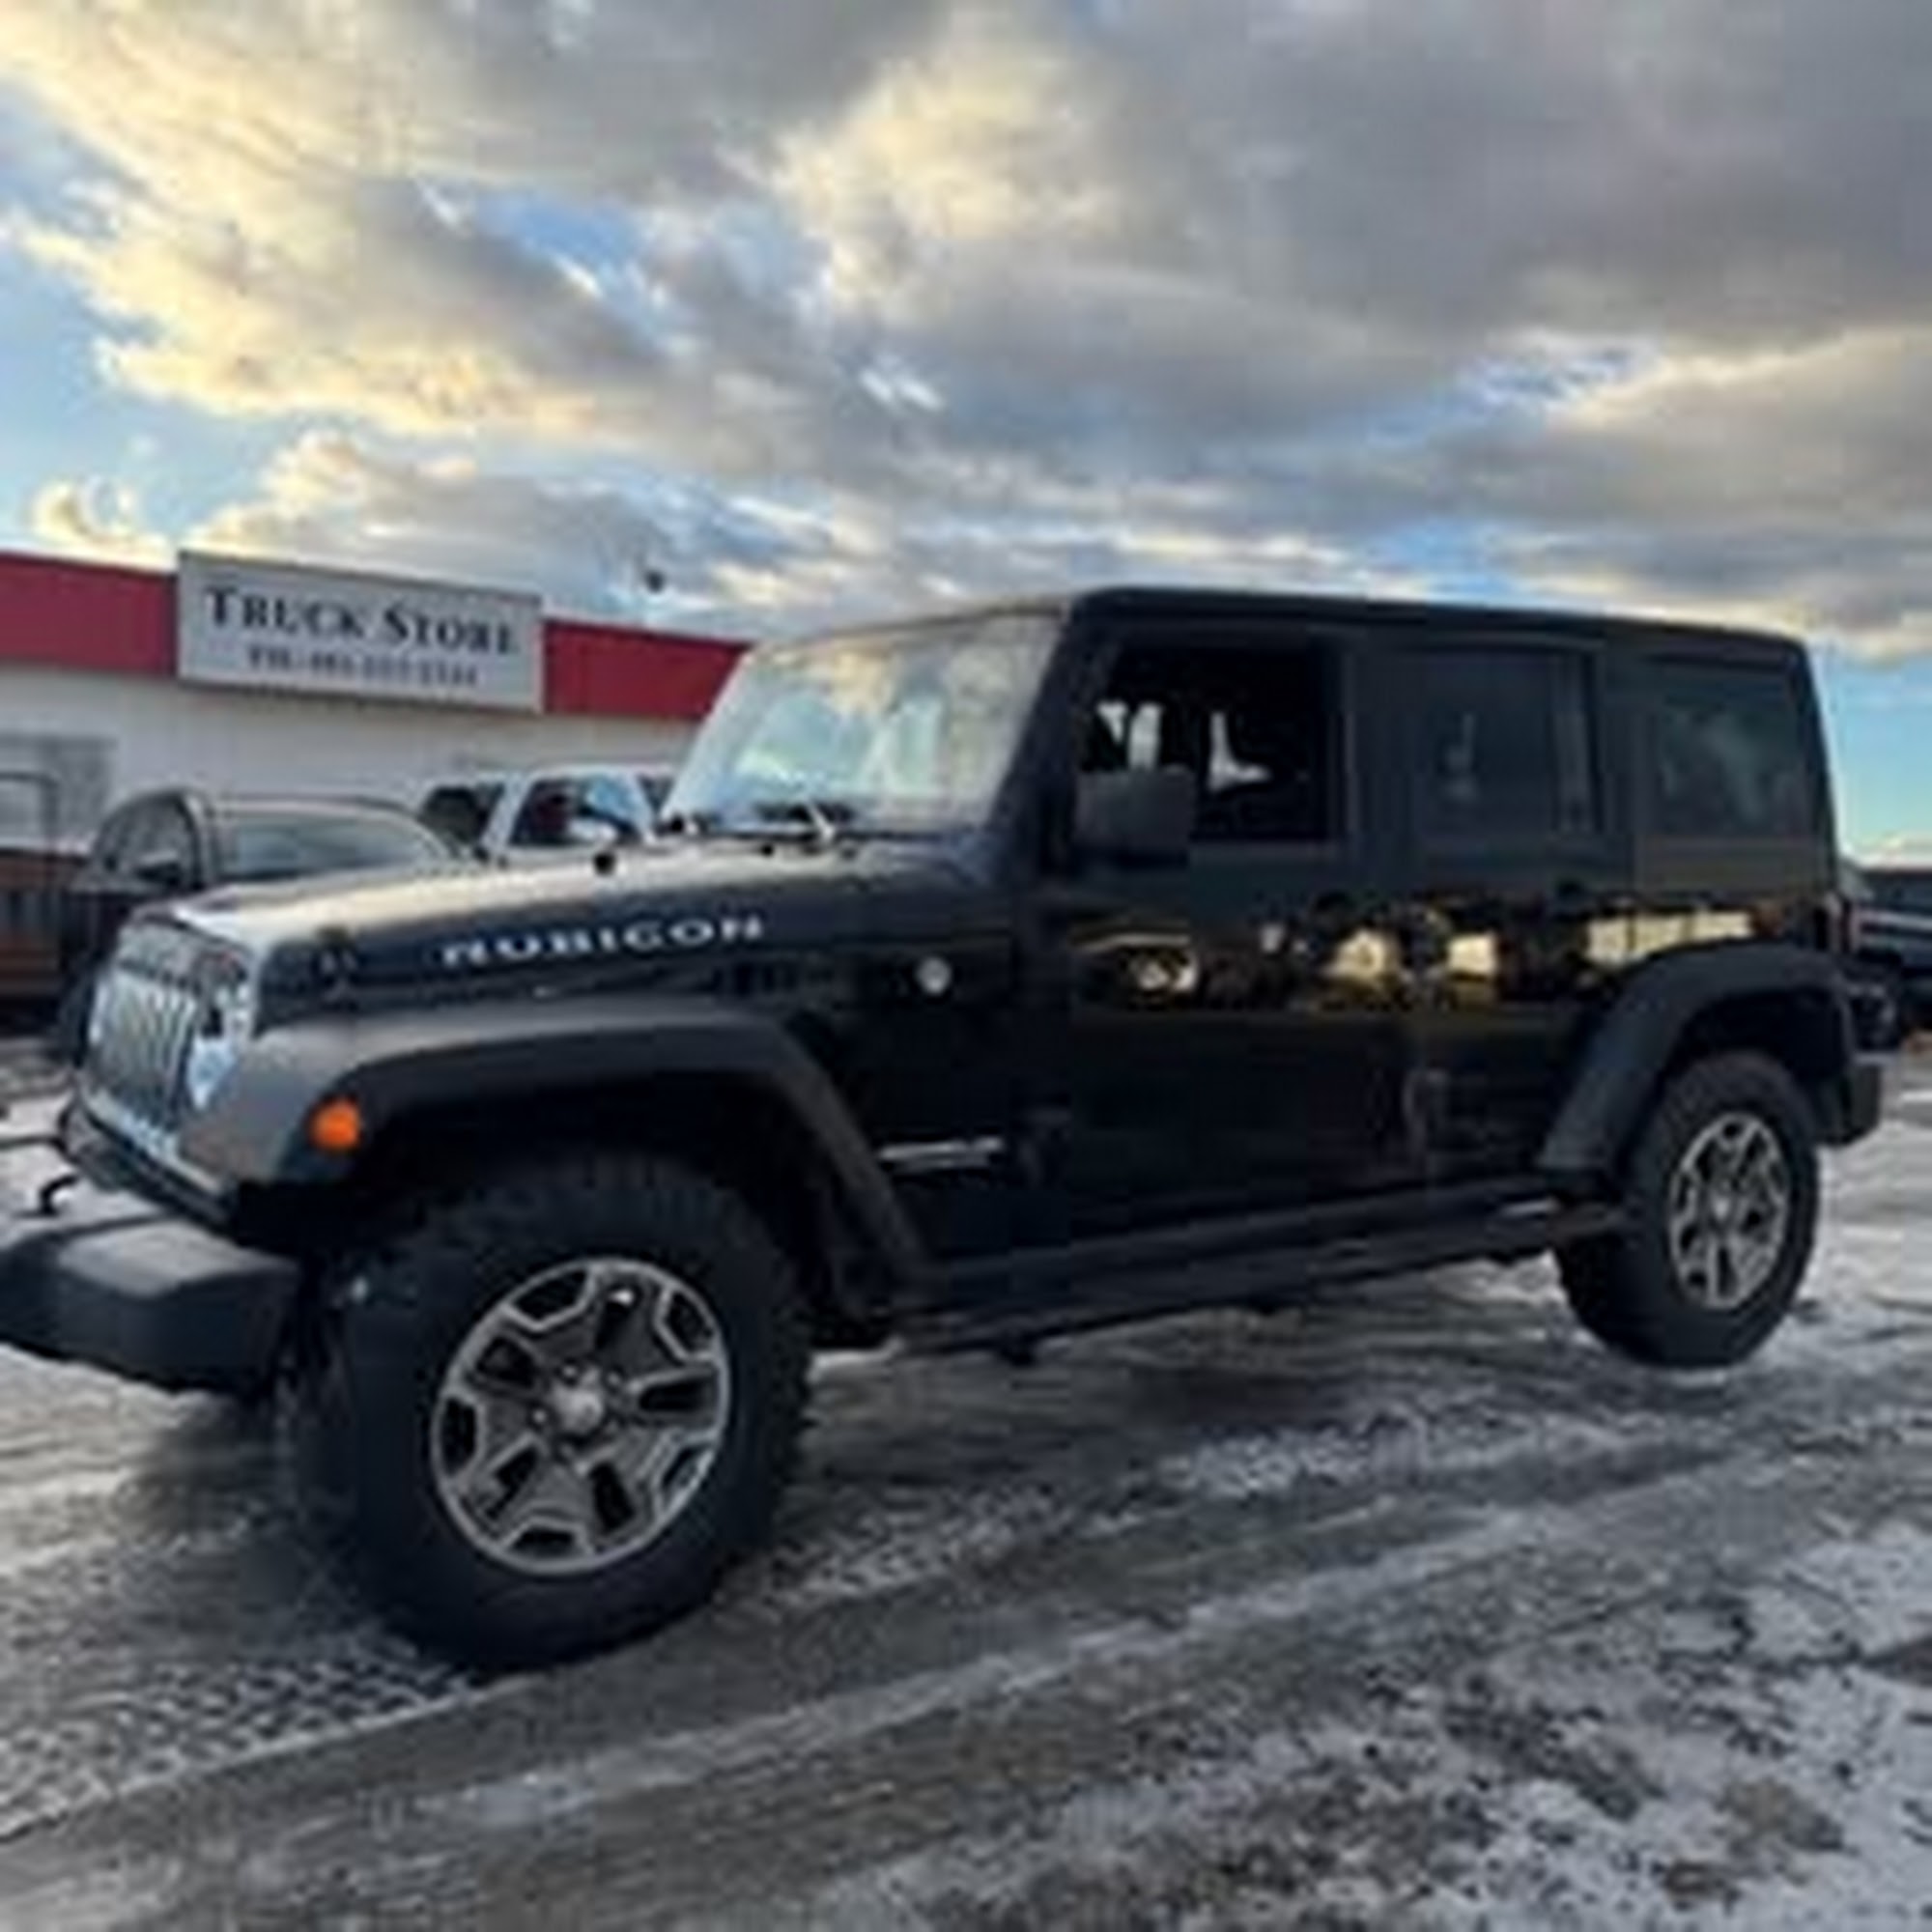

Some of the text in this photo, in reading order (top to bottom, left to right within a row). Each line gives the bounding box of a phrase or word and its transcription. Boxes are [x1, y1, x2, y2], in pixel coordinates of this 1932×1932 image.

[204, 584, 516, 654] TRUCK STORE
[439, 914, 765, 967] RUBICON
